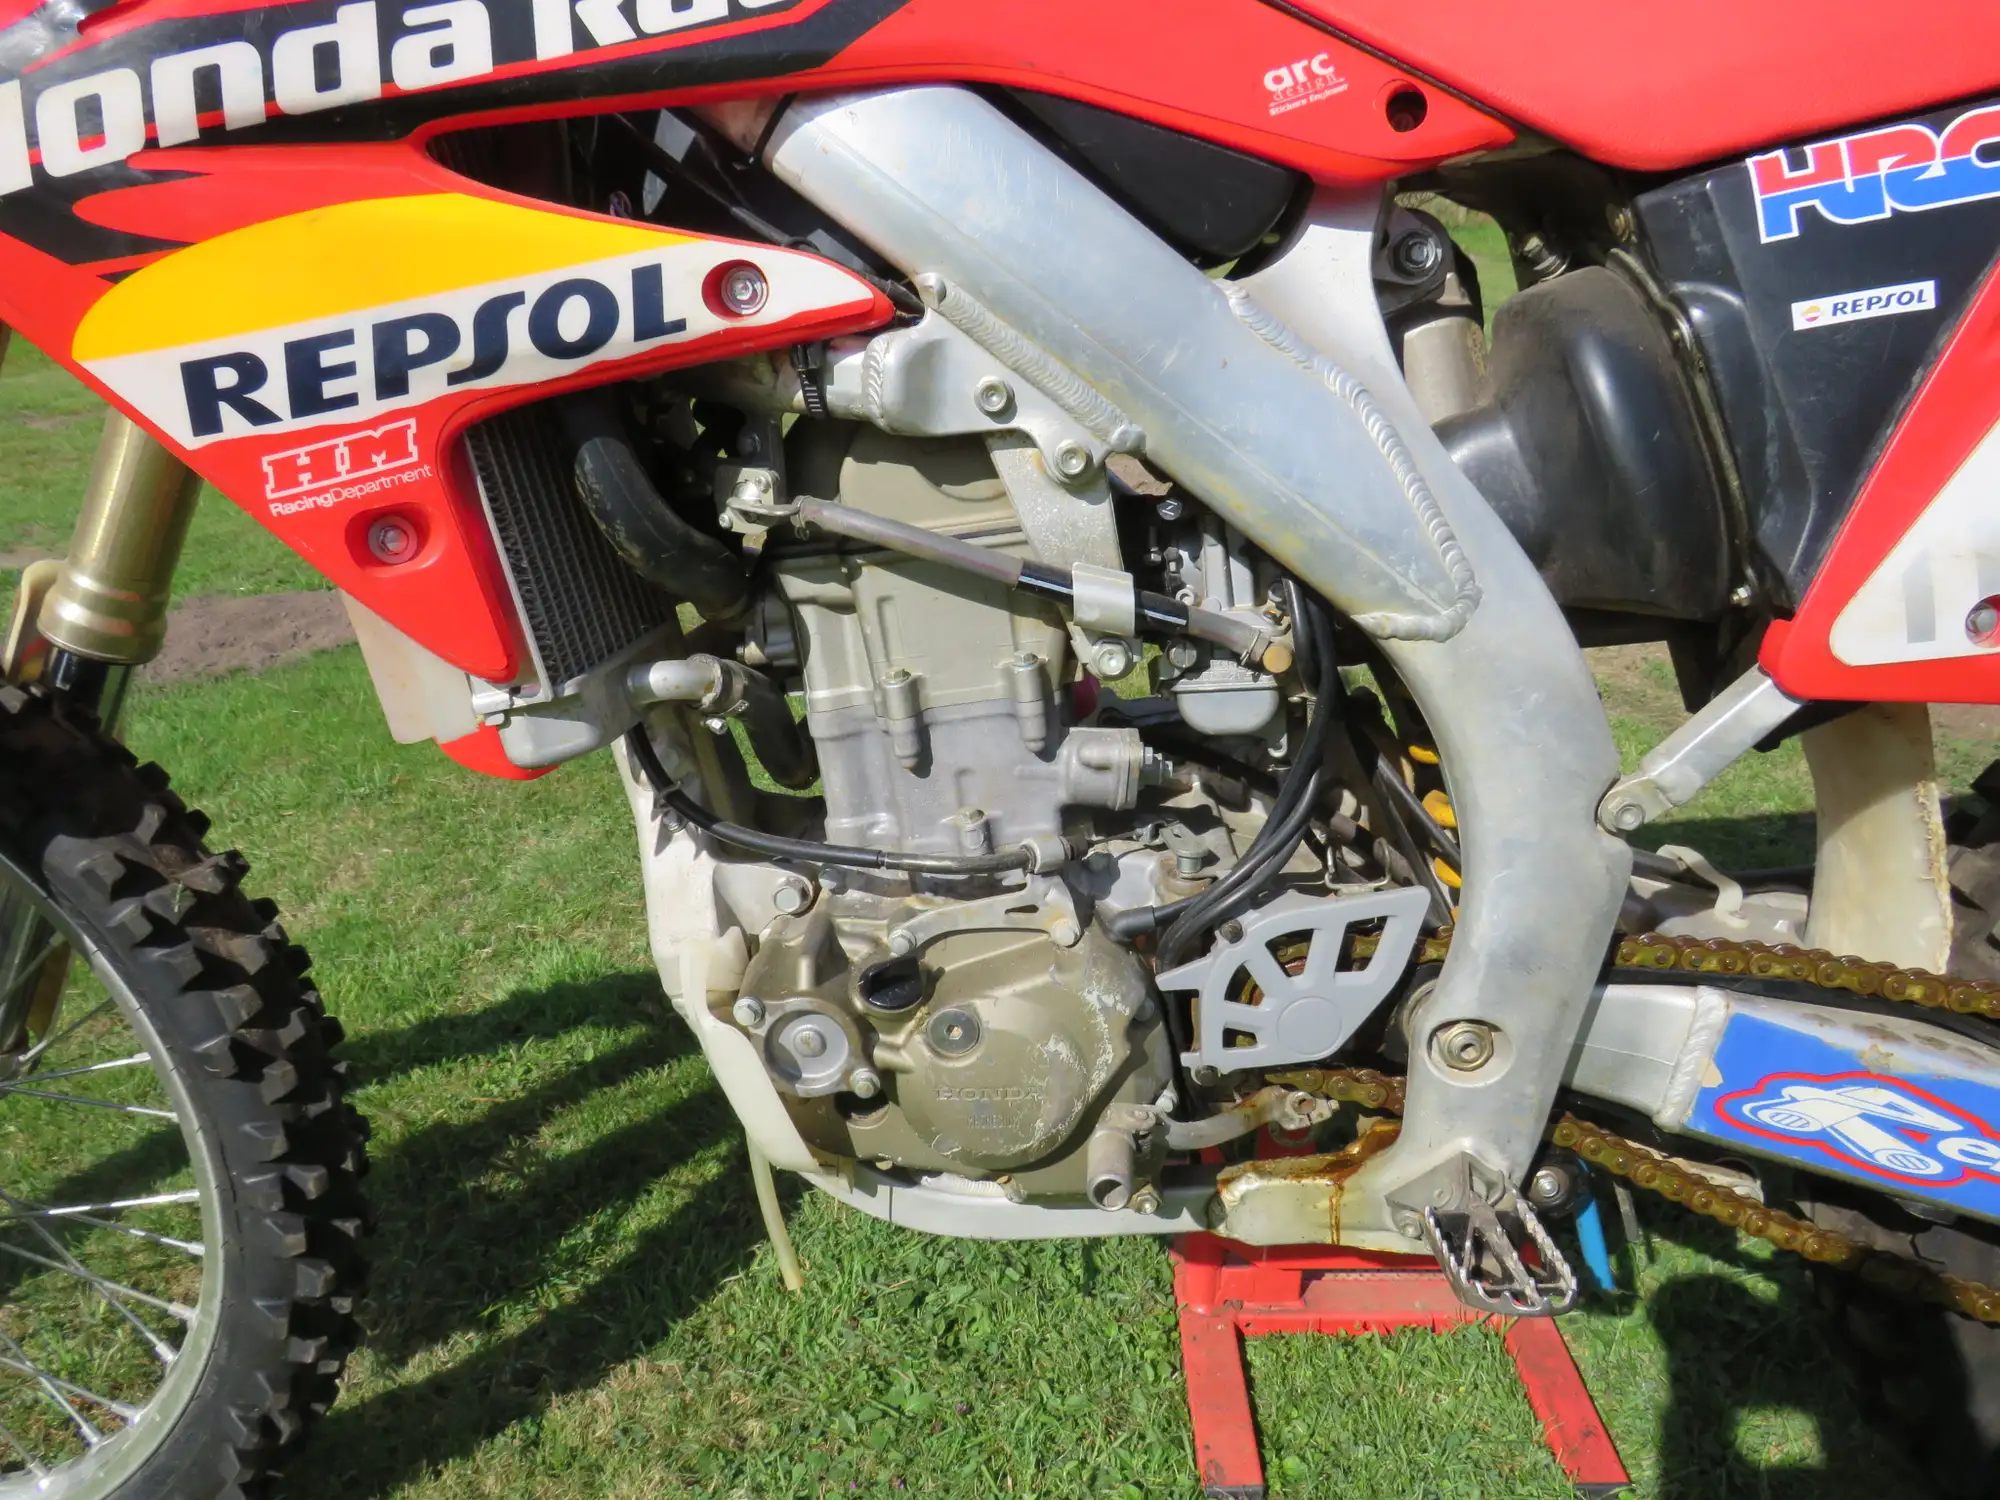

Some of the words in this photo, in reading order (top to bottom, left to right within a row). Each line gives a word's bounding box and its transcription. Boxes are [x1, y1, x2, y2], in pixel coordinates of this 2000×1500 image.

[1263, 53, 1335, 92] arc
[1831, 288, 1928, 318] REPSOL
[180, 262, 688, 438] REPSOL
[934, 1086, 1047, 1102] HONDA
